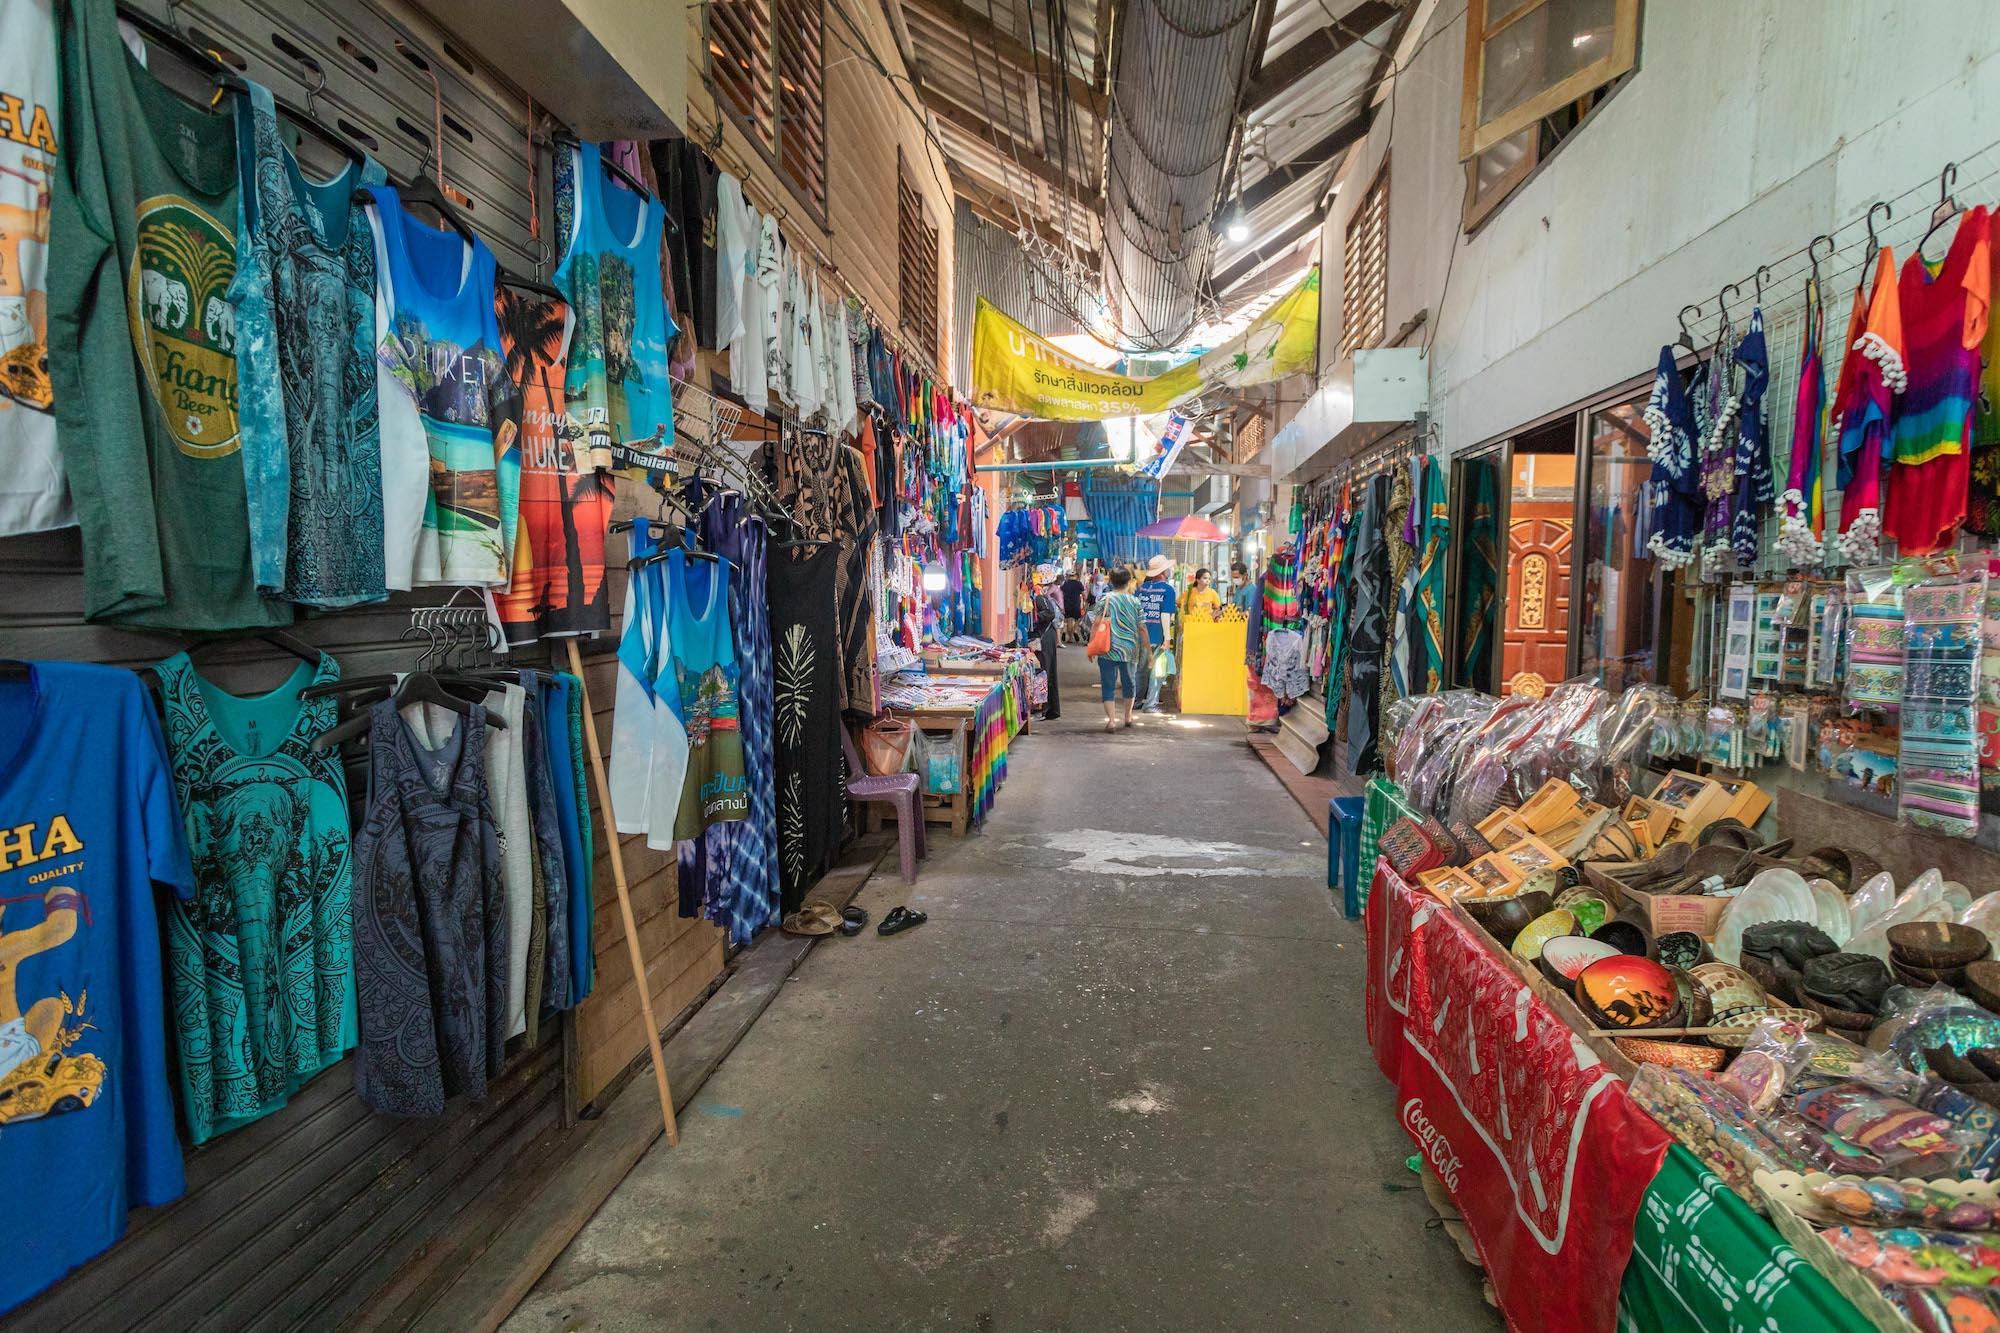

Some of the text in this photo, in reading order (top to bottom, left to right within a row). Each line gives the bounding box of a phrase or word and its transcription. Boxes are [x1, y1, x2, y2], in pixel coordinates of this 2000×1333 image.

[1033, 368, 1144, 397] รักษาสิ่งแวดล้อม
[171, 388, 218, 415] Beer
[1099, 400, 1142, 415] 35%
[523, 405, 568, 435] njoy
[522, 434, 570, 471] HUKE
[28, 861, 84, 885] QUALITY
